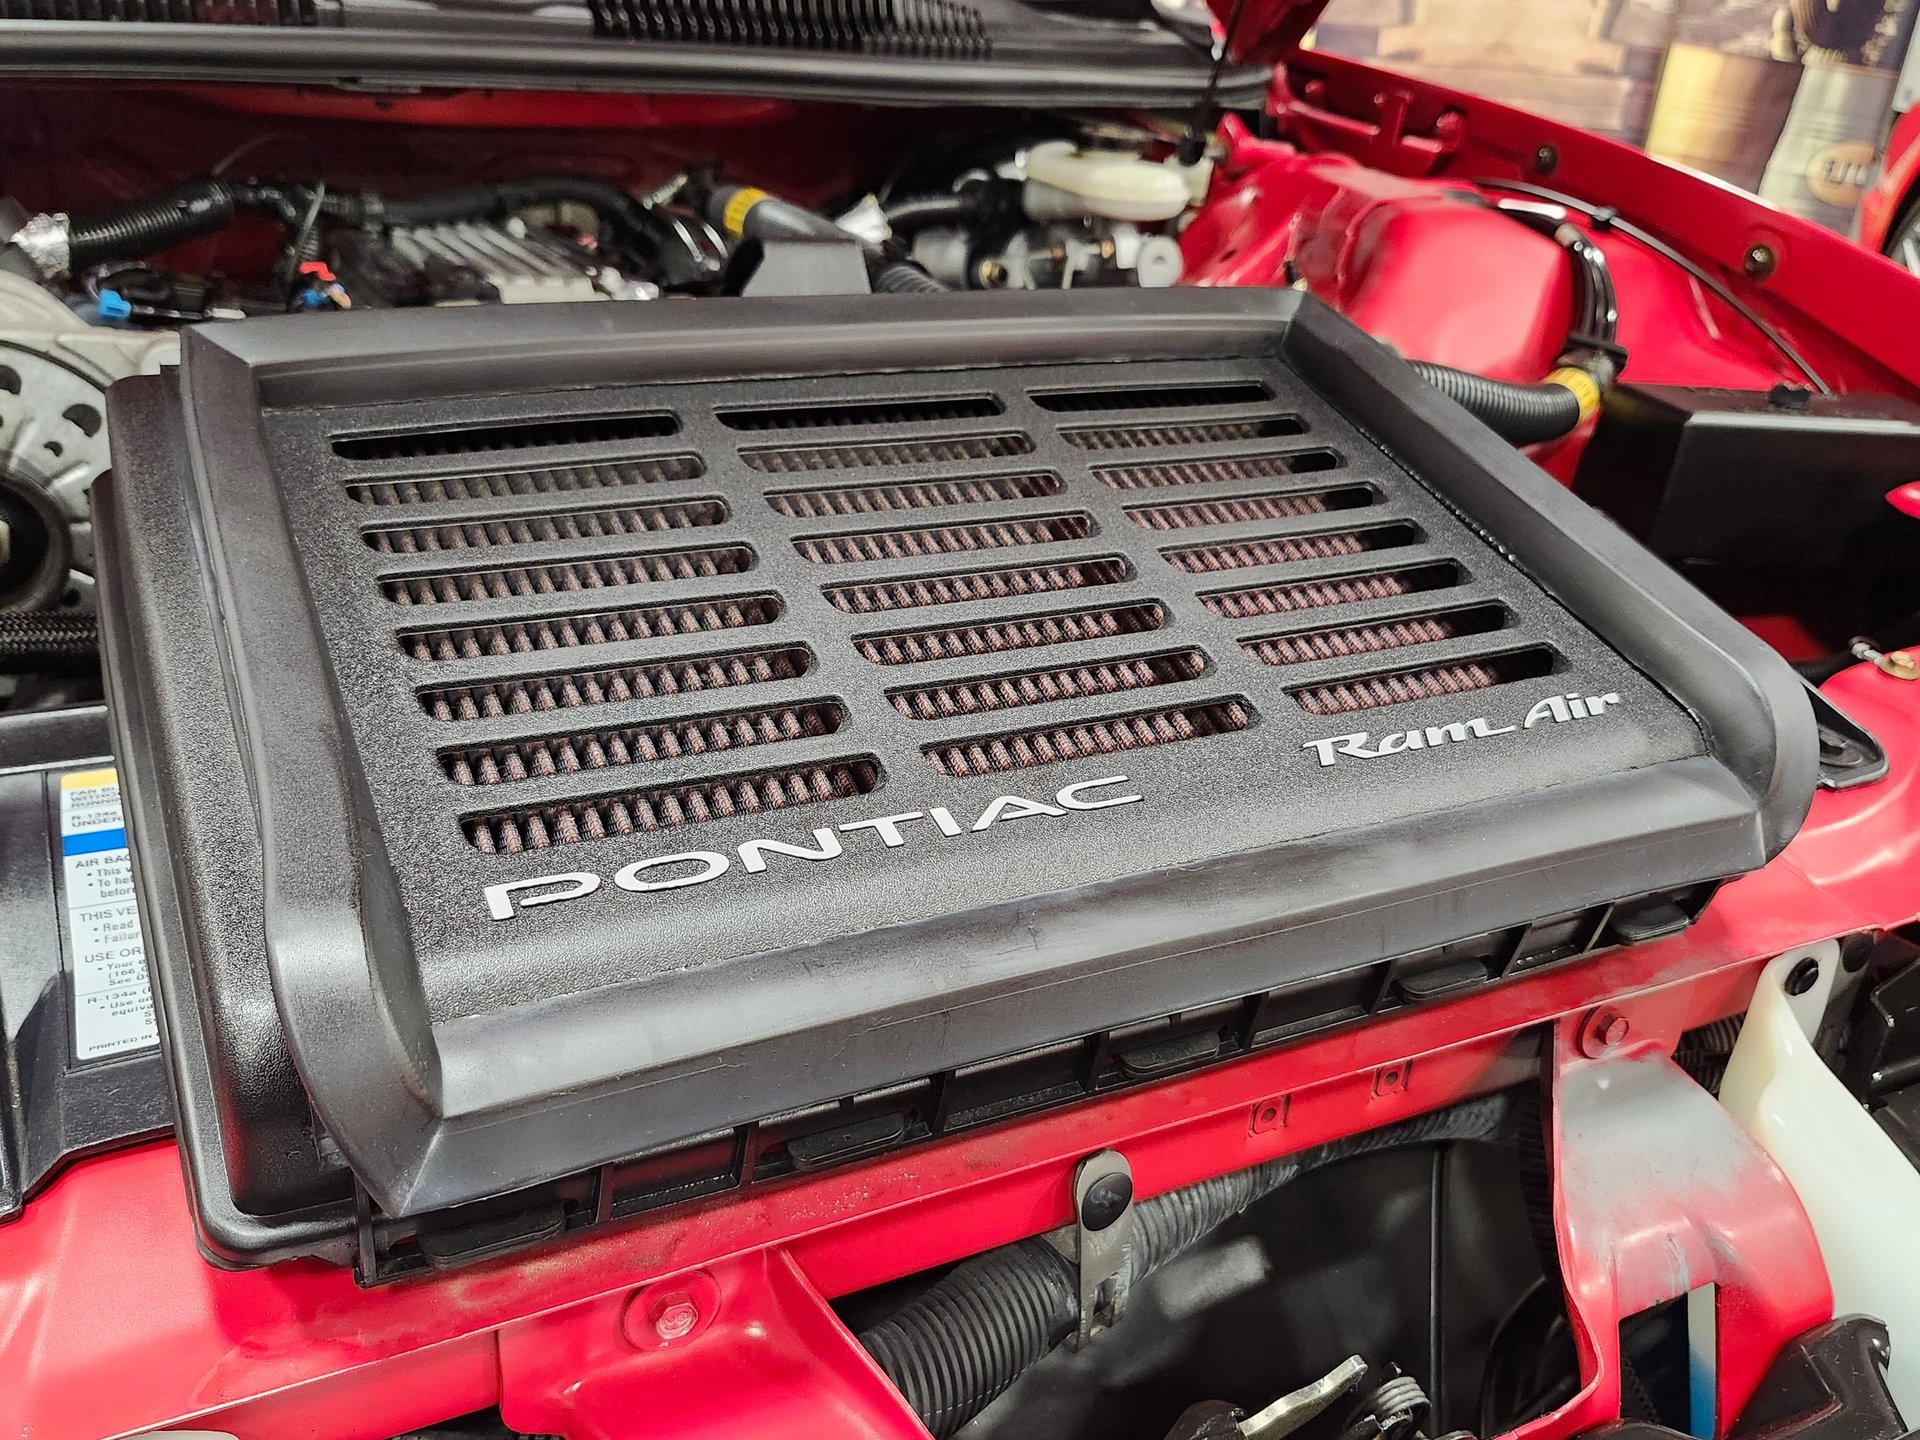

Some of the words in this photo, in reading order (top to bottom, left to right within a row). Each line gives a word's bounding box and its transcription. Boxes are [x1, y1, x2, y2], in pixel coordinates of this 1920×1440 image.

[1301, 717, 1516, 767] Ram
[1522, 692, 1620, 729] Air
[482, 774, 1143, 921] PONTIAC
[75, 858, 99, 868] AIR
[97, 868, 121, 876] This
[98, 879, 111, 887] To
[80, 909, 113, 921] THIS
[103, 920, 134, 932] Read
[104, 931, 140, 943] Failur
[85, 951, 115, 963] USE
[107, 961, 133, 970] Your
[87, 991, 137, 1004] R-134a
[110, 1000, 133, 1008] Use
[89, 1037, 138, 1052] PRINTED
